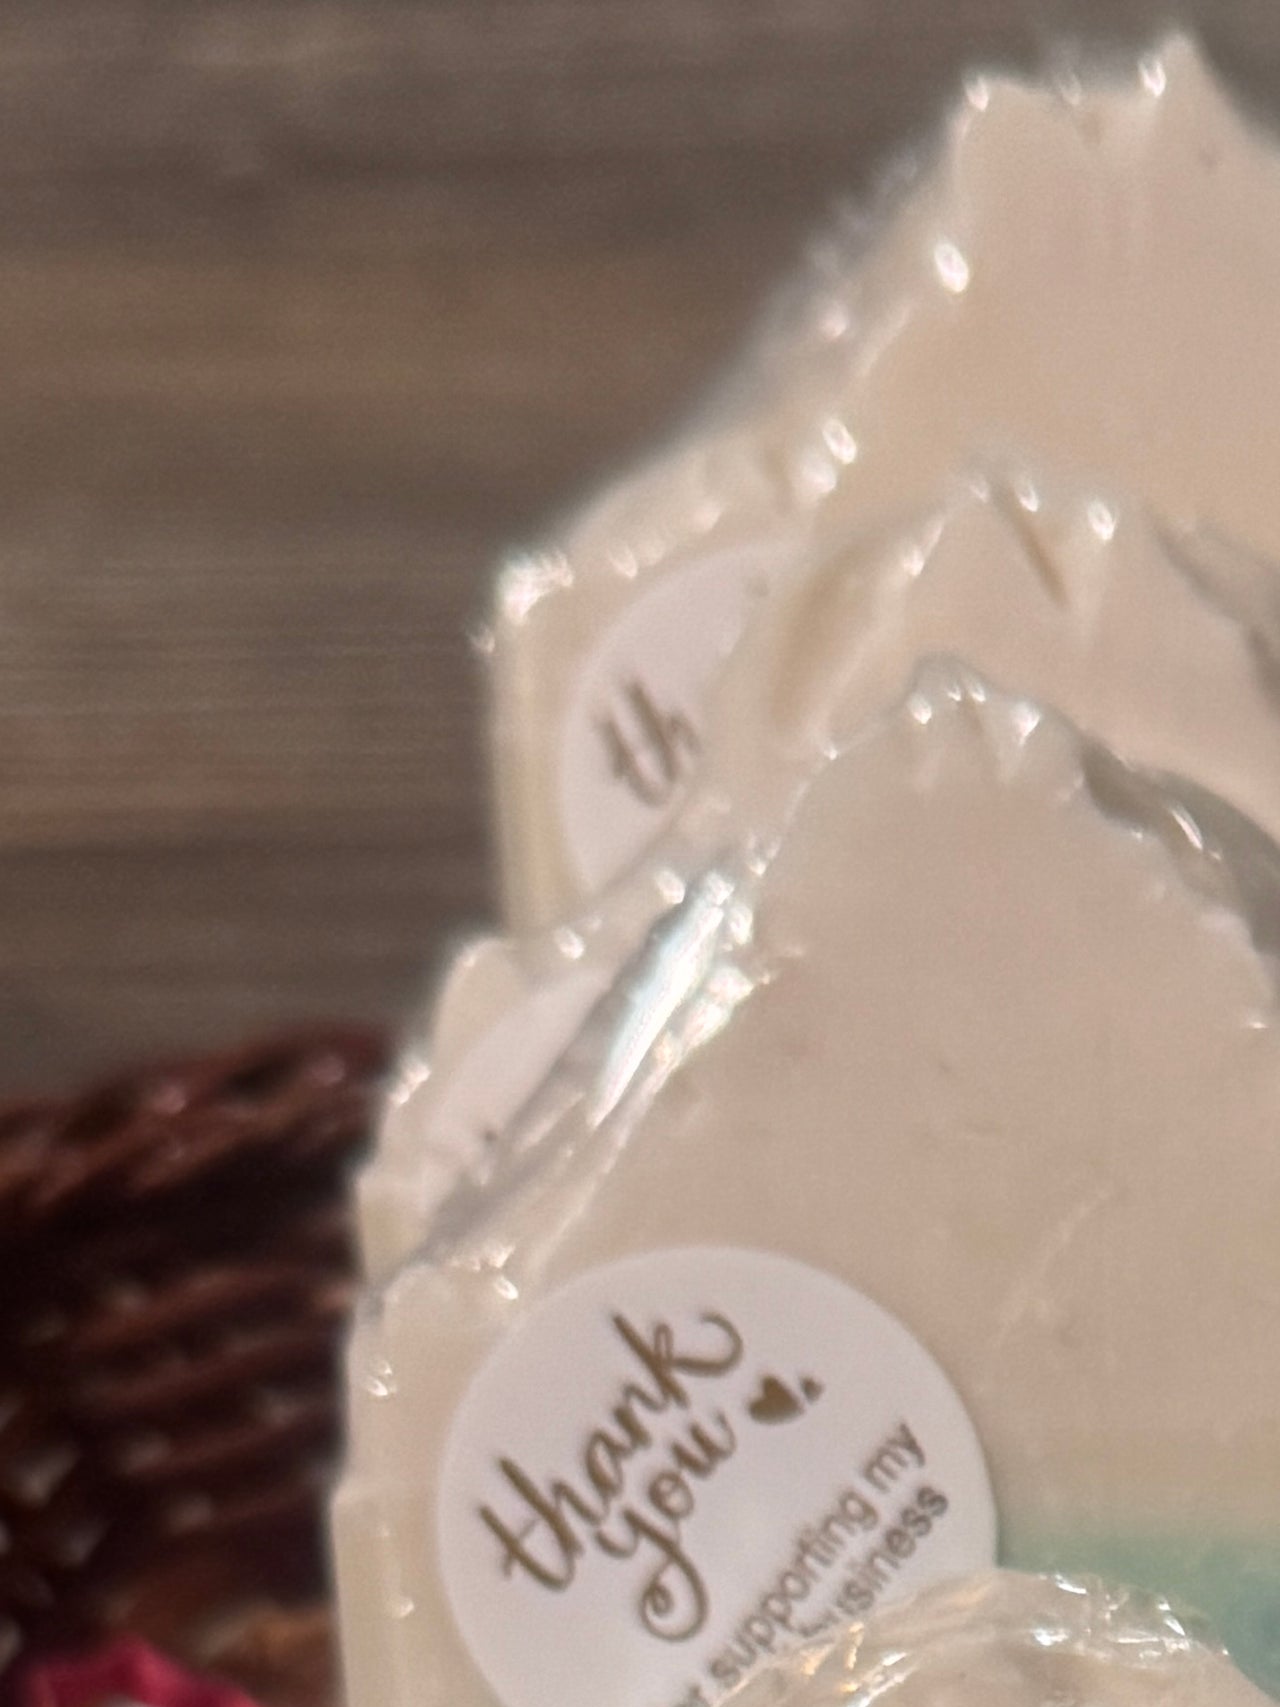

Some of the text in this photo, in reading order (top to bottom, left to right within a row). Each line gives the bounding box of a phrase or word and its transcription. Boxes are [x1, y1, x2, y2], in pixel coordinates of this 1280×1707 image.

[478, 1311, 743, 1591] thank
[597, 1411, 736, 1642] you
[862, 1422, 926, 1494] my
